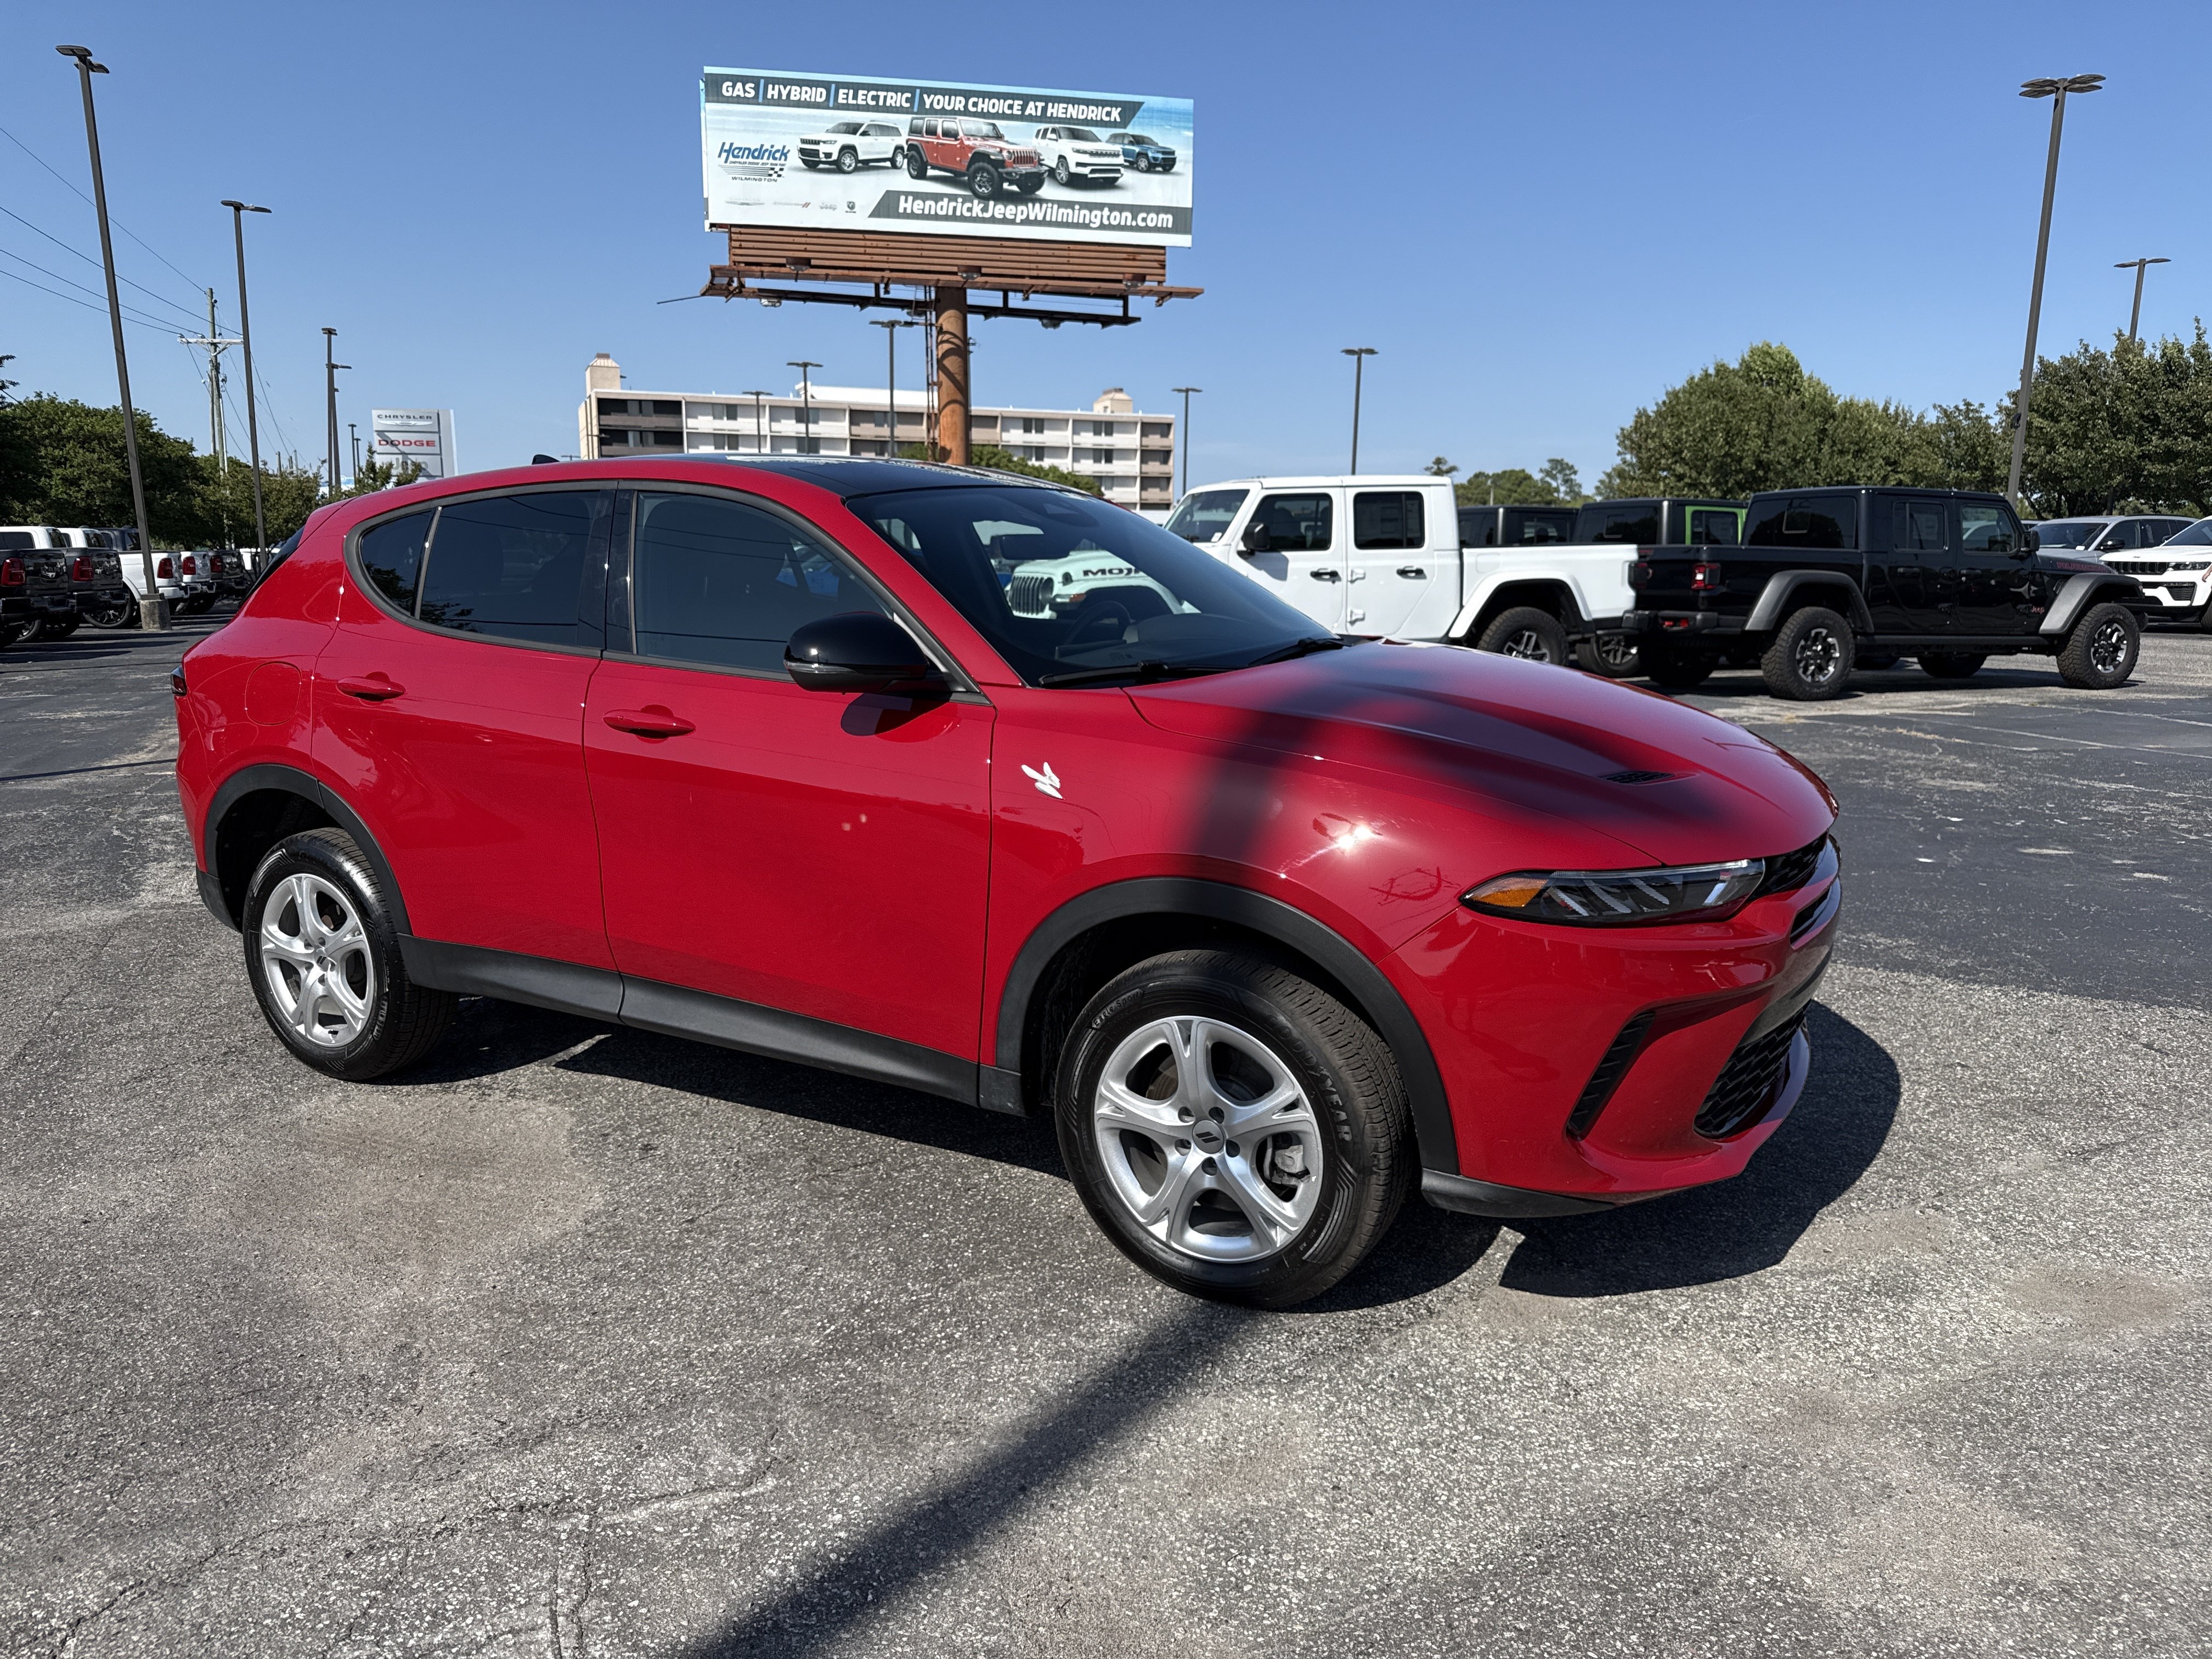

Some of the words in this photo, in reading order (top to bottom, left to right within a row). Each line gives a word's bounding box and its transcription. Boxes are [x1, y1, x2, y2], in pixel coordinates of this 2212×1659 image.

[722, 81, 755, 98] GAS
[767, 84, 827, 102] HYBRID
[837, 88, 912, 108] ELECTRIC
[923, 94, 965, 111] YOUR
[967, 97, 1022, 114] CHOICE
[1025, 100, 1045, 116] AT
[1047, 103, 1122, 121] HENDRICK
[718, 142, 791, 163] Hendrick
[898, 195, 1173, 228] HendrickJeepWilmington.com
